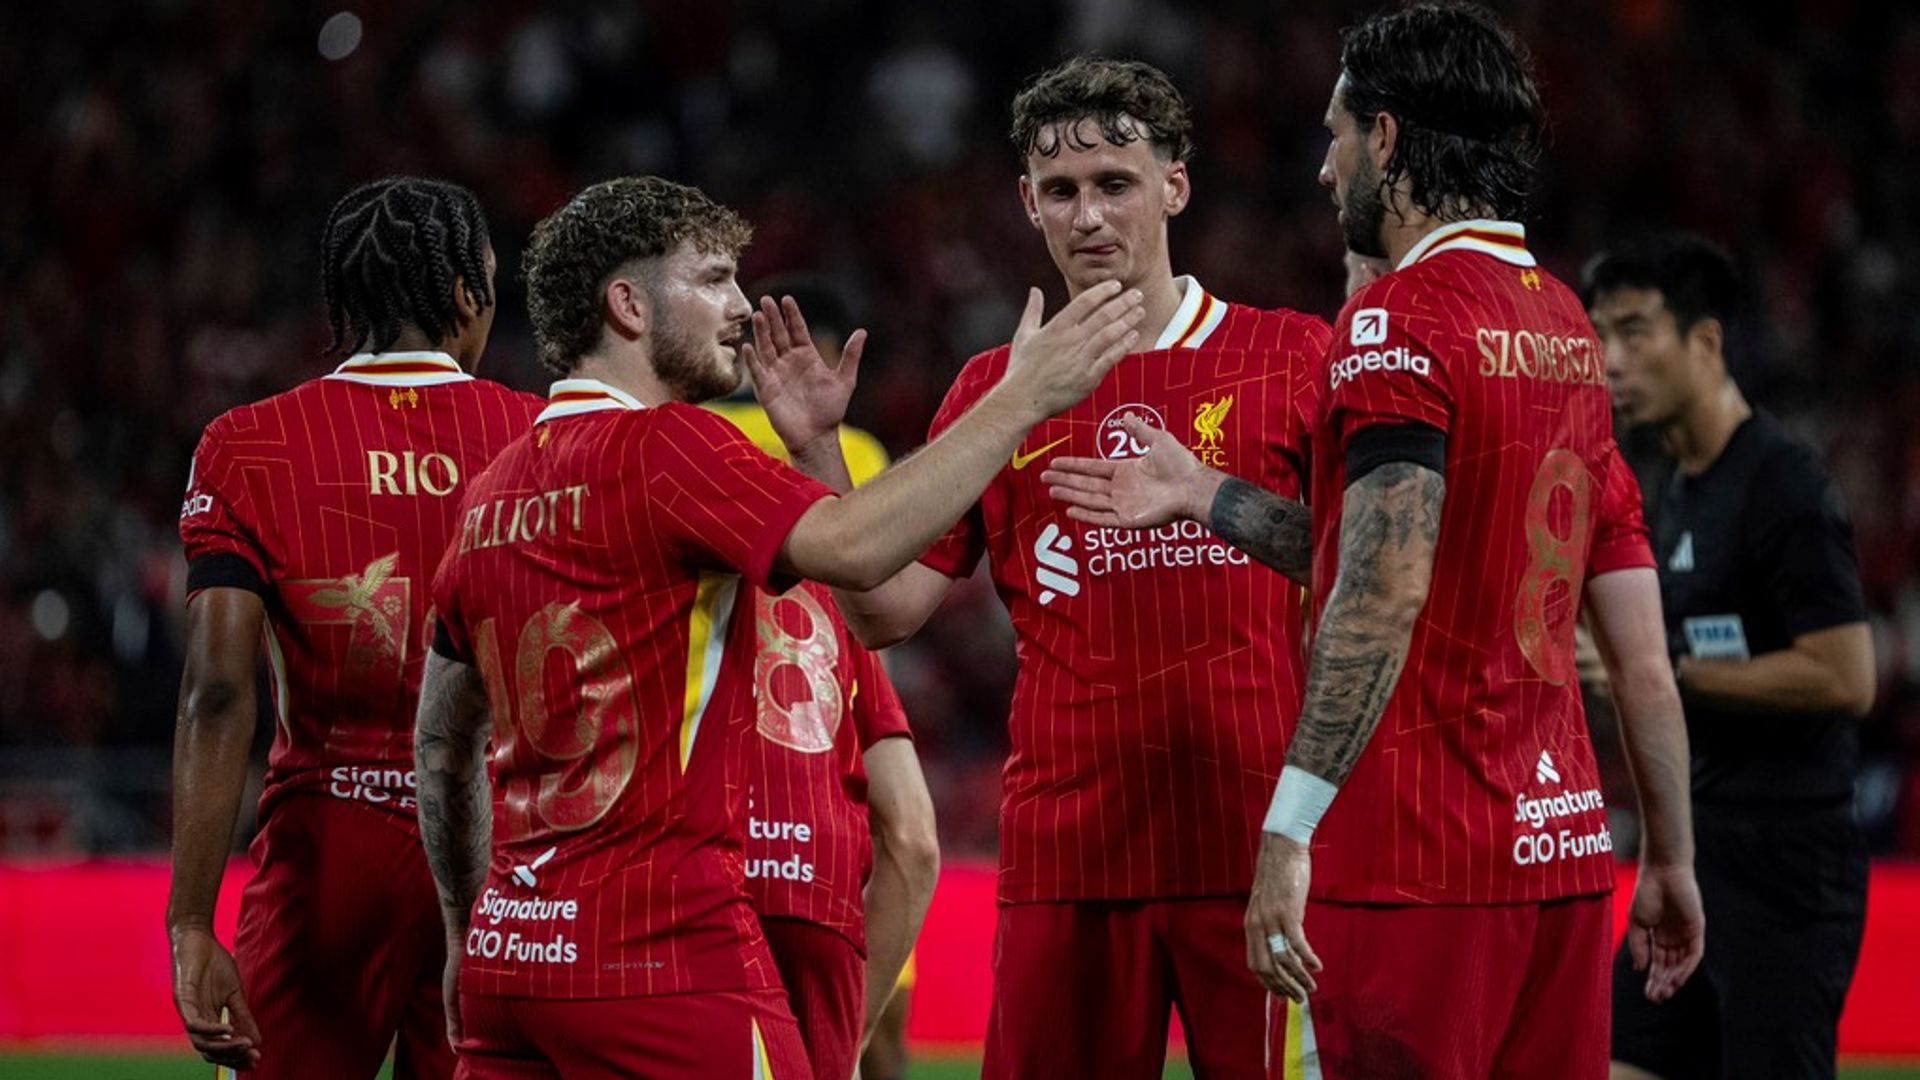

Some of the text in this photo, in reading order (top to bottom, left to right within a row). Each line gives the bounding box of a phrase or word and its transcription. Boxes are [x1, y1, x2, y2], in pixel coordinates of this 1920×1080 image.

[1330, 346, 1430, 391] Expedia
[1476, 327, 1607, 386] SZOBOSZL
[367, 450, 459, 497] RIO
[180, 489, 214, 519] edia
[459, 484, 591, 554] ELLIOTT
[1084, 519, 1211, 550] standa
[1514, 449, 1591, 686] 8
[474, 599, 640, 832] 19
[331, 766, 418, 788] Signa
[1515, 789, 1605, 828] Signature
[1513, 822, 1613, 865] CIO Funds
[744, 853, 815, 883] unds
[478, 888, 578, 925] Signature
[466, 927, 578, 963] CIO Funds
